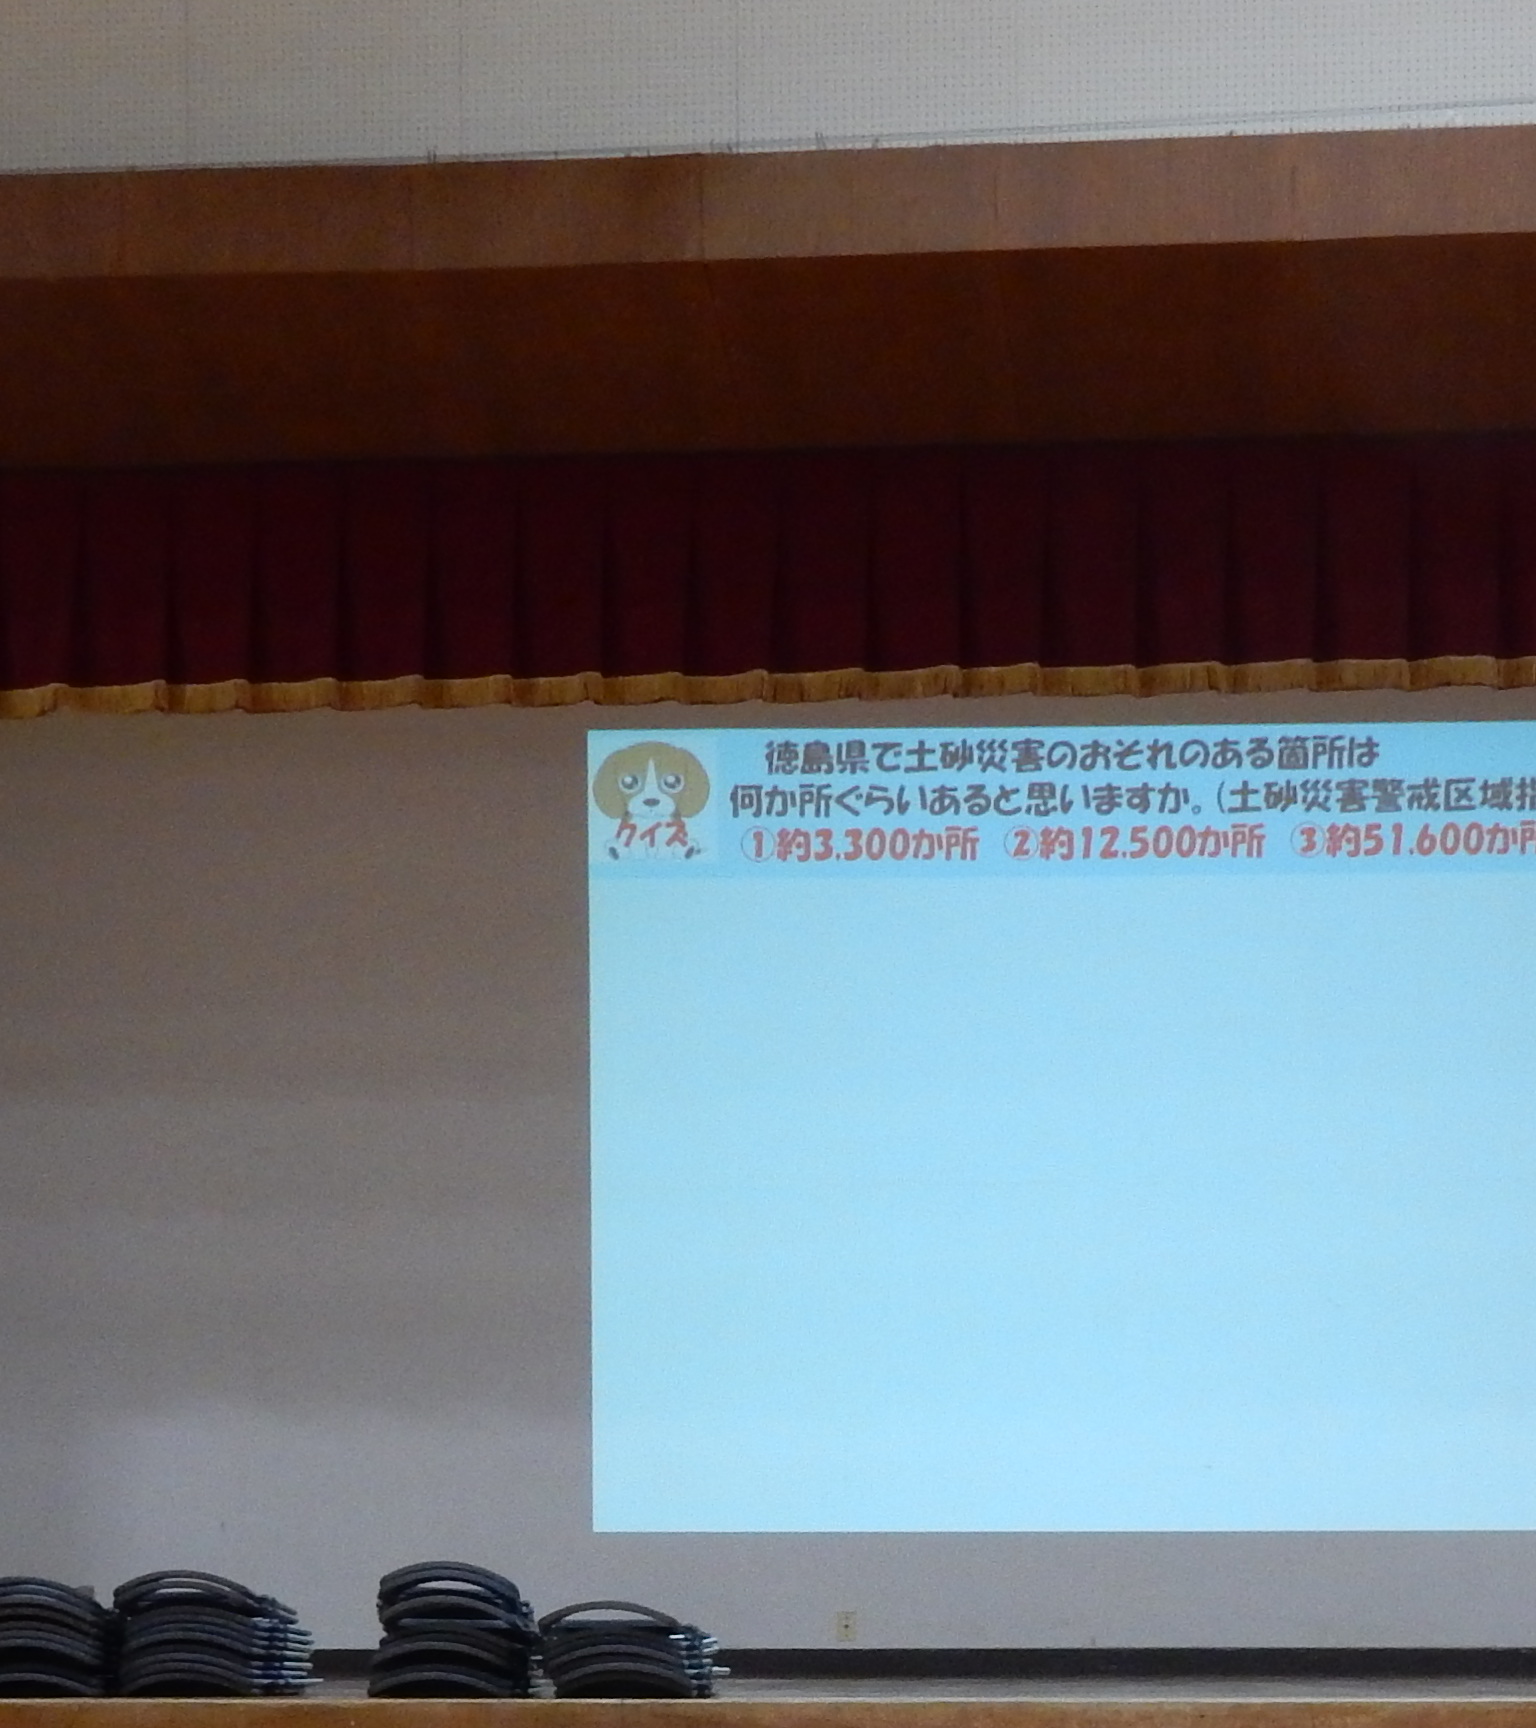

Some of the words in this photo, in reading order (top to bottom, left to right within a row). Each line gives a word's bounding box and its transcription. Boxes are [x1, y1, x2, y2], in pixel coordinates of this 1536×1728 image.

[765, 735, 1380, 775] 徳島県で土砂災害のおそれのある箇所は
[616, 821, 688, 847] クイズ
